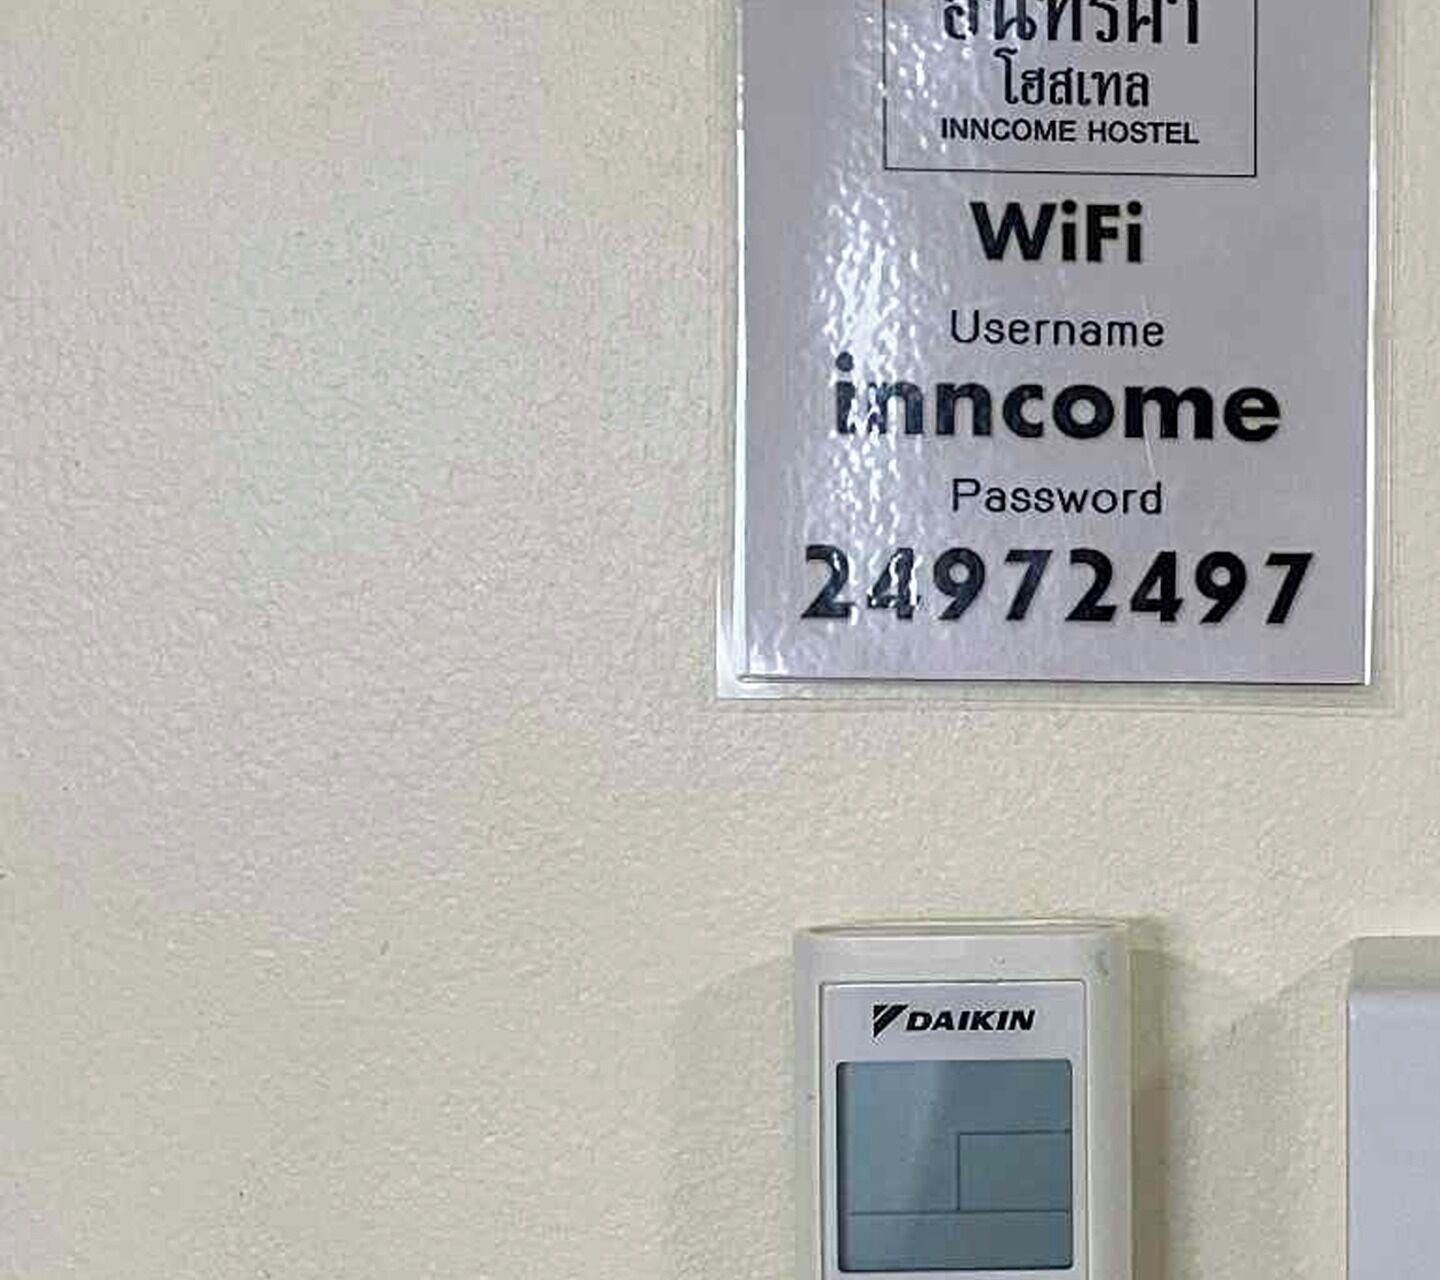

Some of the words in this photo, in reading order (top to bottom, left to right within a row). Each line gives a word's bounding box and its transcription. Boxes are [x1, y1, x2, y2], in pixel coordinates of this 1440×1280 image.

[993, 47, 1149, 107] โฮสเทล
[941, 117, 1077, 143] INNCOME
[1087, 120, 1200, 145] HOSTEL
[970, 200, 1143, 264] WiFi
[950, 309, 1164, 348] Username
[834, 352, 1282, 443] inncome
[952, 478, 1162, 515] Password
[800, 544, 1314, 625] 24972497
[905, 1007, 1036, 1031] DAIKIN
